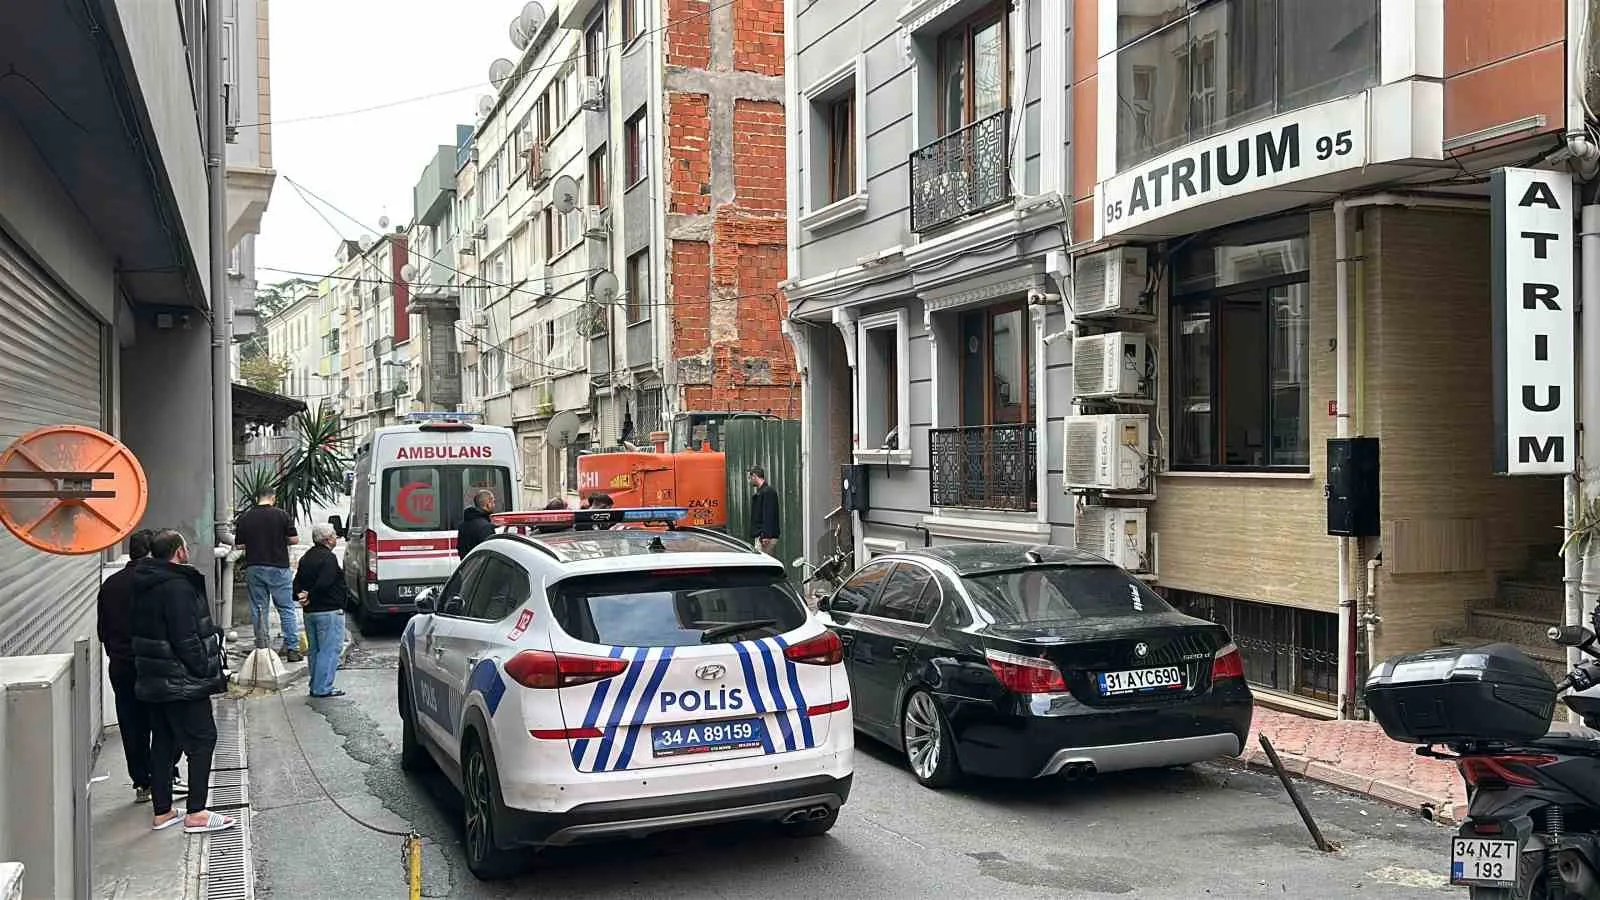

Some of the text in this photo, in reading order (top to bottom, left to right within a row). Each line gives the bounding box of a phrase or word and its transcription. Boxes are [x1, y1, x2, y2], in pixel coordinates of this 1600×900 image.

[1106, 123, 1353, 223] 95 ATRIUM 95
[1518, 181, 1565, 464] ATRIUM
[396, 446, 492, 460] AMBULANS
[412, 494, 433, 511] 112
[1107, 668, 1179, 689] 31 AYC690
[661, 684, 743, 712] POLİS
[661, 723, 752, 745] 34 A 89159
[1456, 841, 1515, 859] 34 NZT
[1475, 862, 1503, 878] 193
